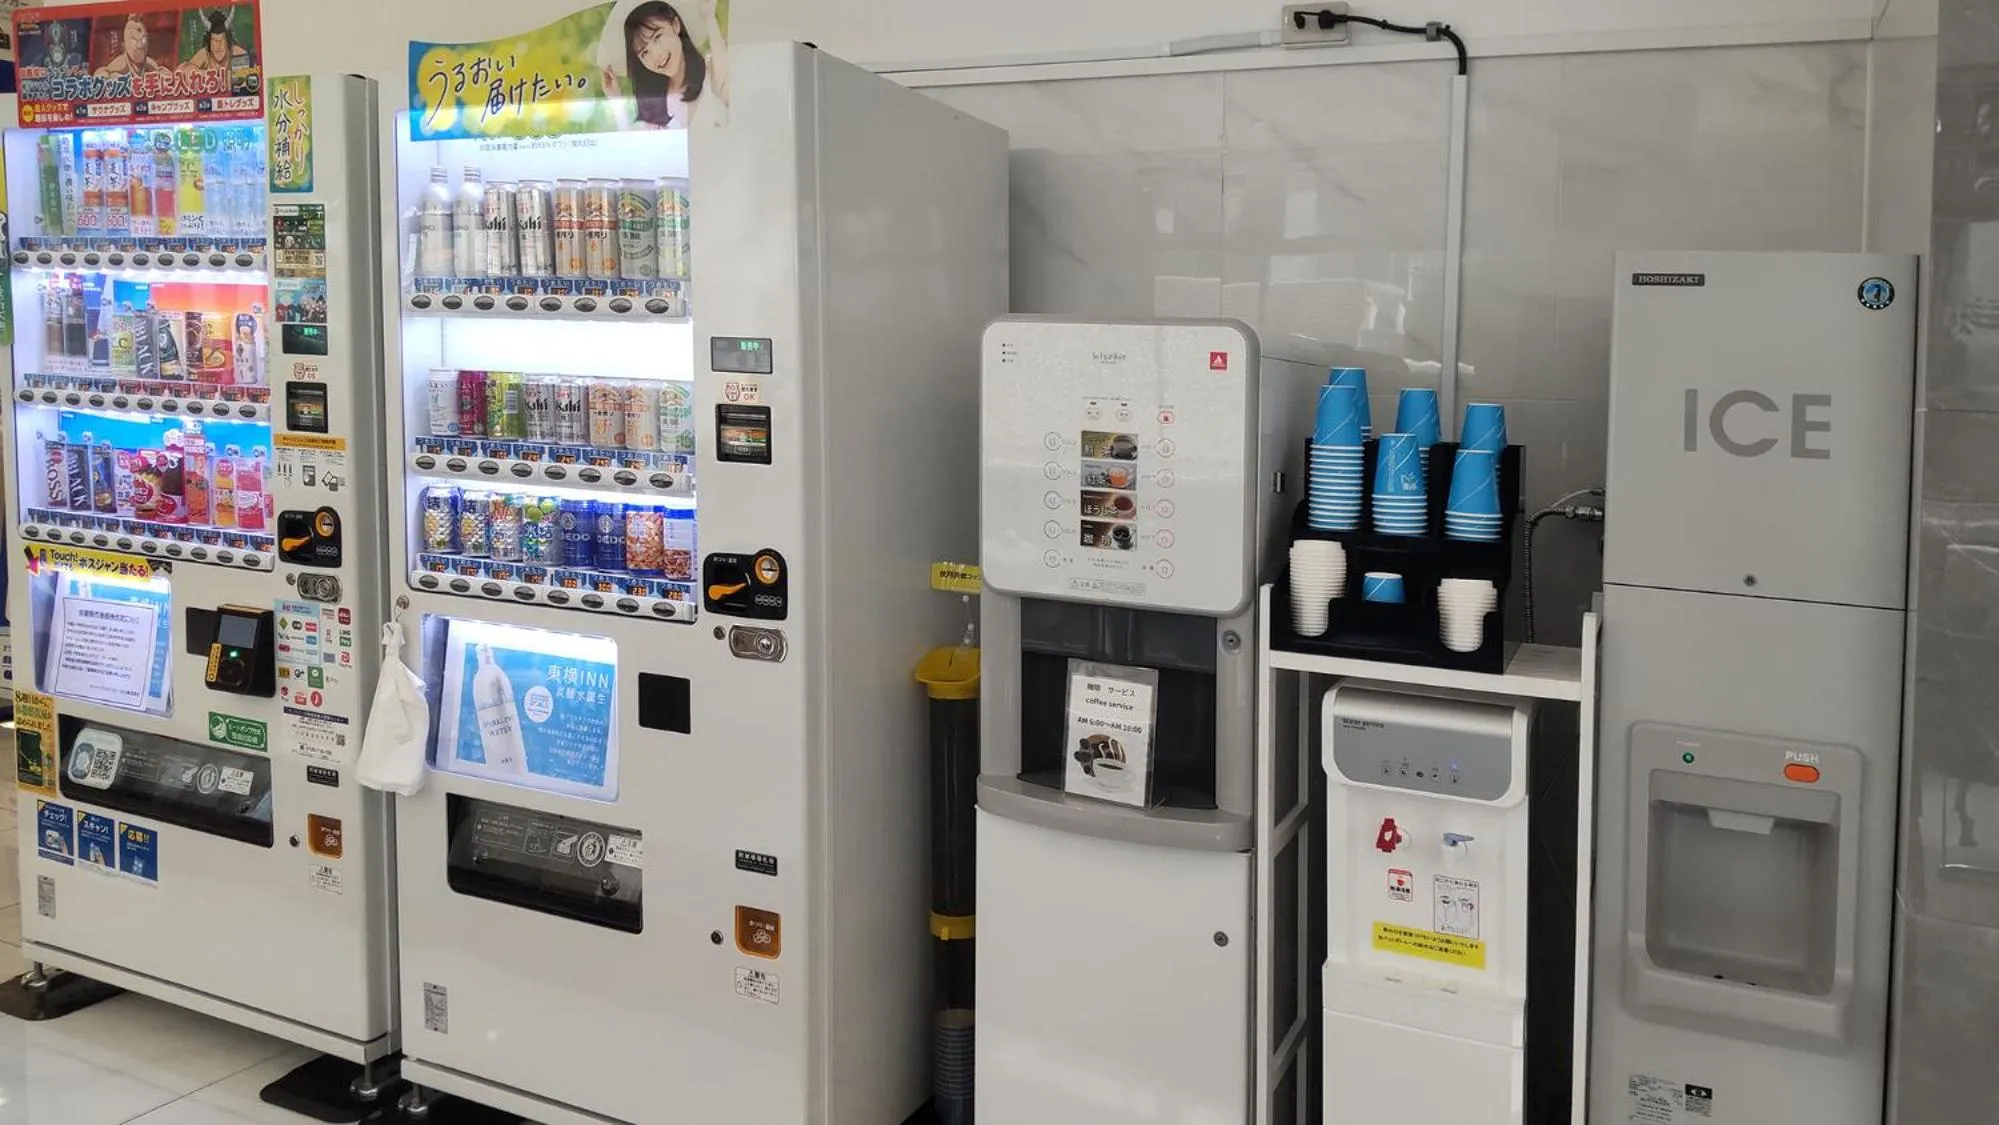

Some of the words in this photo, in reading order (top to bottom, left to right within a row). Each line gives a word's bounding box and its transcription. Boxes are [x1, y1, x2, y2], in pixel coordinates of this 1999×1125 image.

[427, 55, 516, 127] うるおい
[273, 88, 293, 182] 水分補給
[1683, 388, 1831, 460] ICE
[49, 549, 78, 562] Touch!
[545, 663, 609, 690] 東横INN
[1108, 687, 1136, 697] サービス
[1085, 698, 1107, 707] coffee
[1108, 702, 1134, 711] service
[1077, 716, 1088, 724] AM
[1123, 724, 1143, 734] 10:00
[1785, 751, 1820, 764] PUSH
